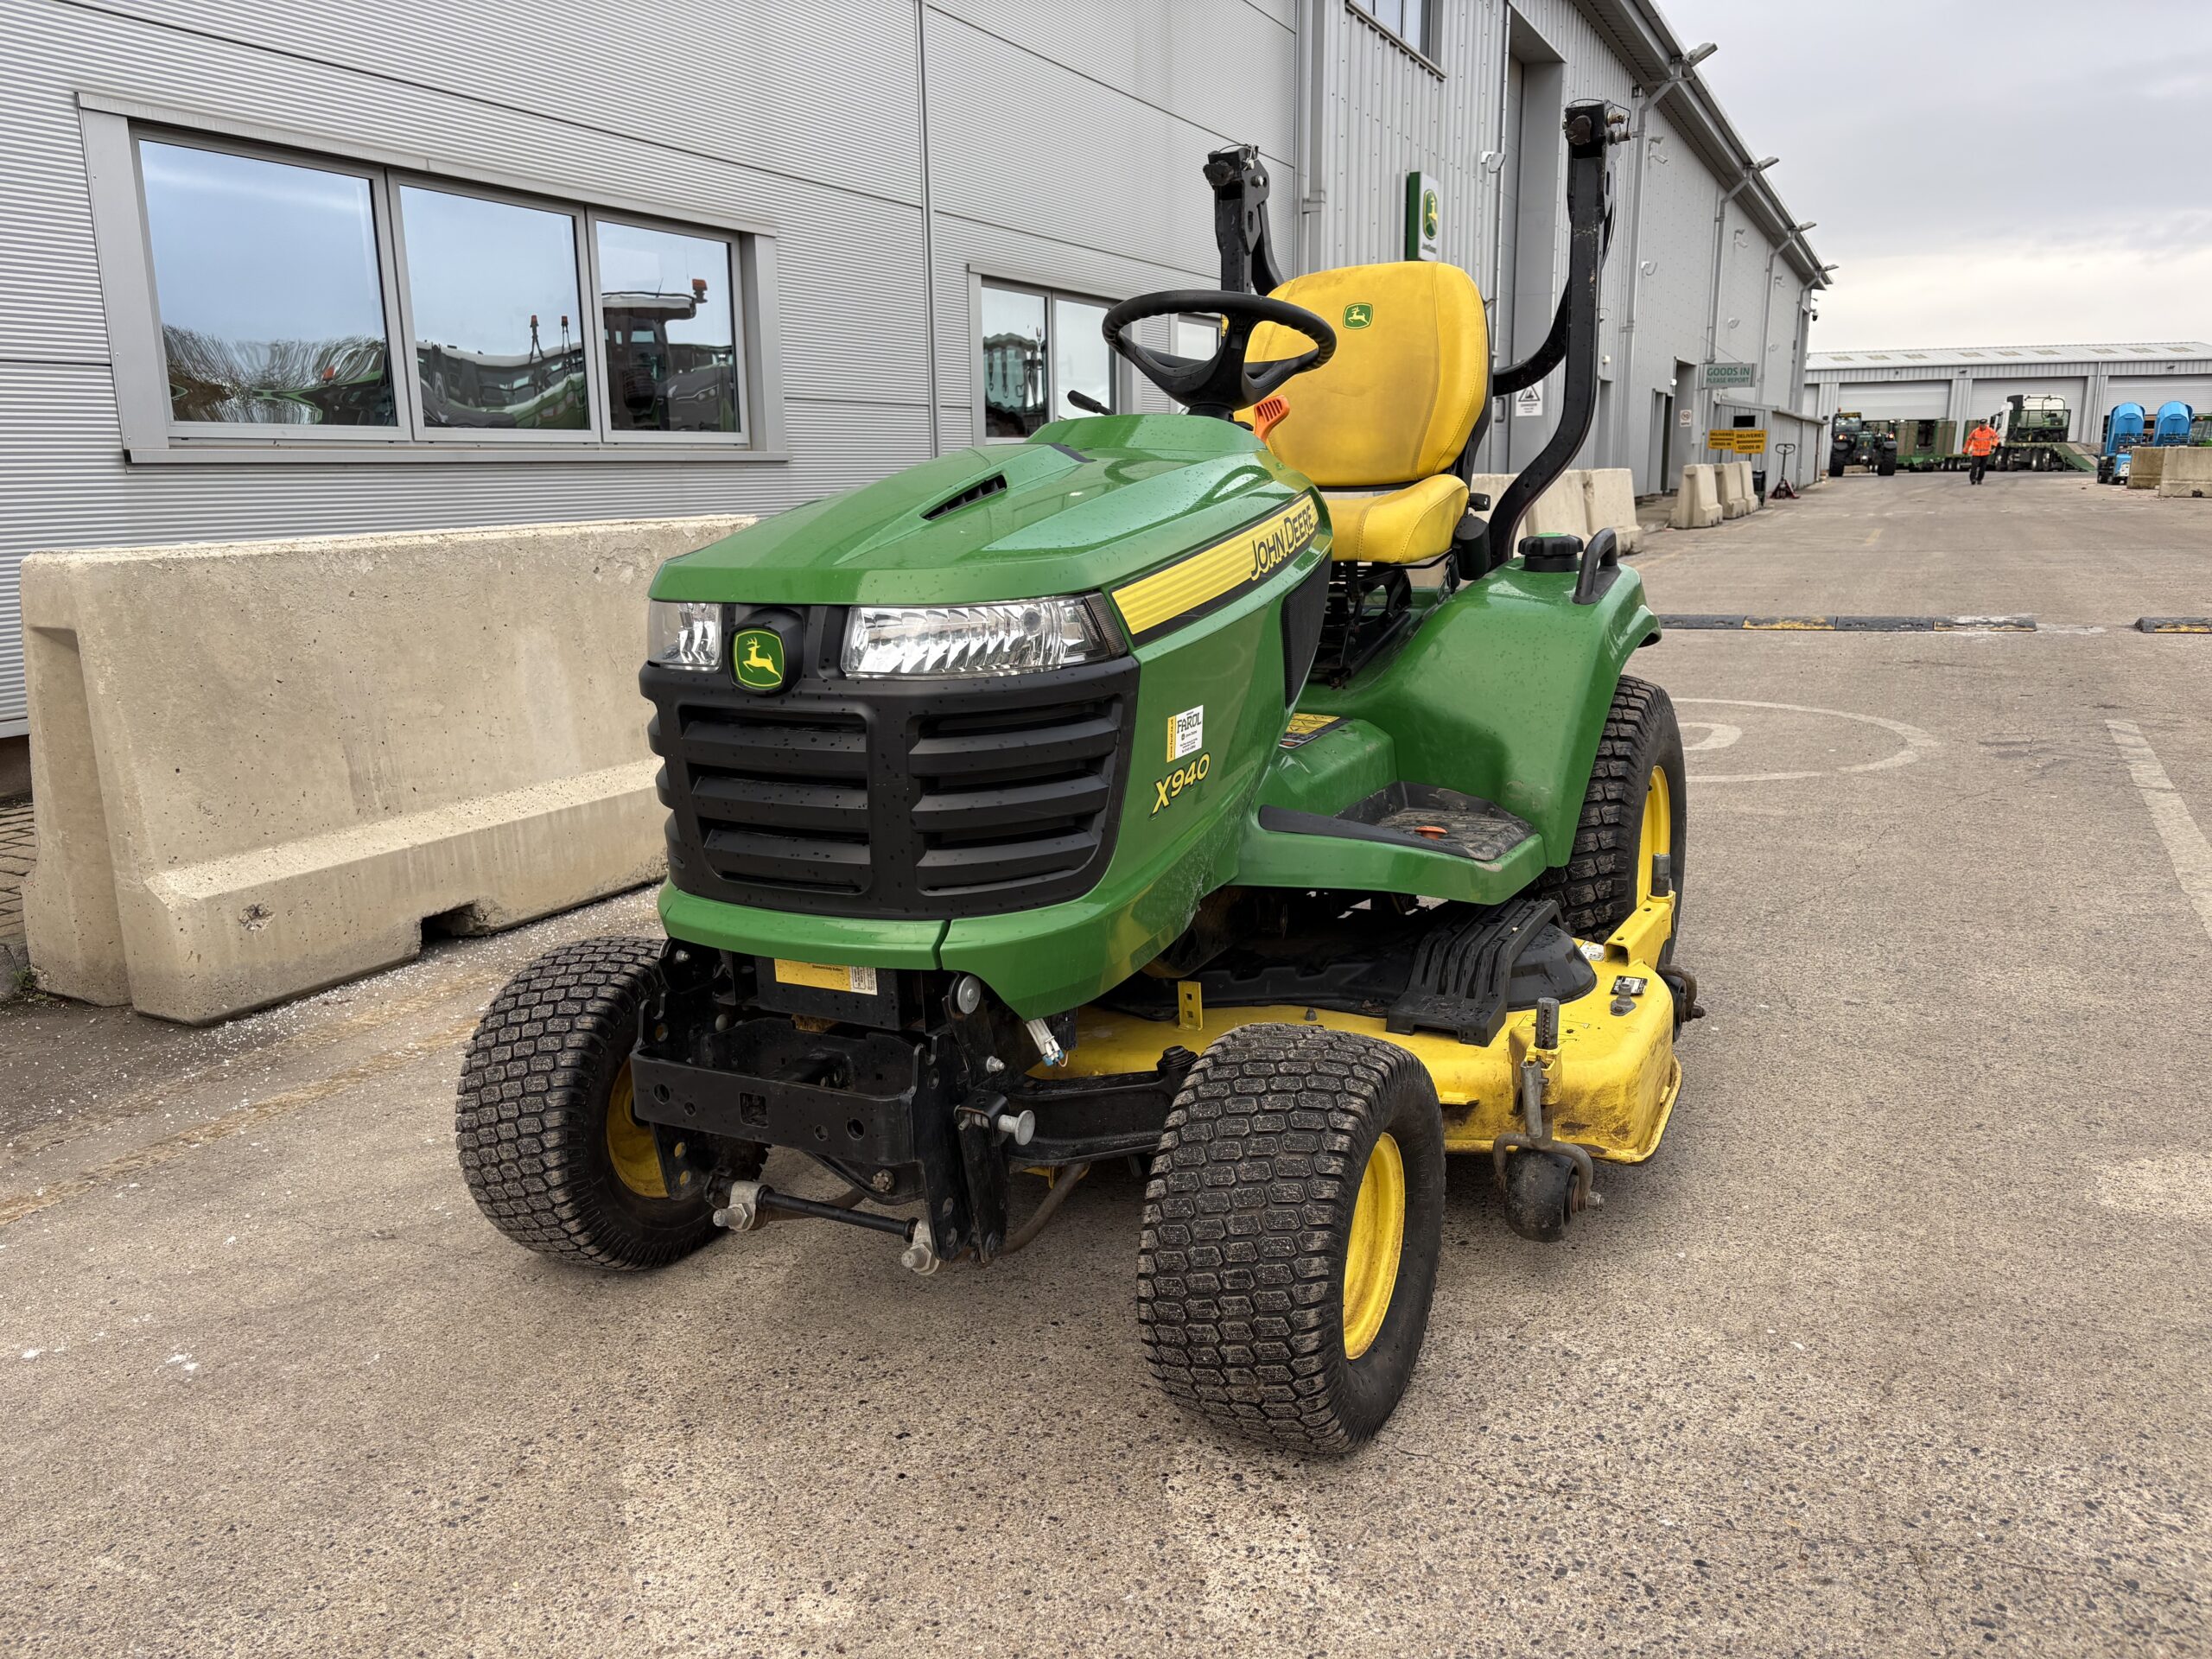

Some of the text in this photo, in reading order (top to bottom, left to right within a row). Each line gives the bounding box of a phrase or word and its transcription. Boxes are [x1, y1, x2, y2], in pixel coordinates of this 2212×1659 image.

[1707, 366, 1750, 376] GOODS IN
[1250, 505, 1314, 580] JOHN DEERE
[1177, 712, 1202, 734] FAROL
[1150, 752, 1211, 817] X940
